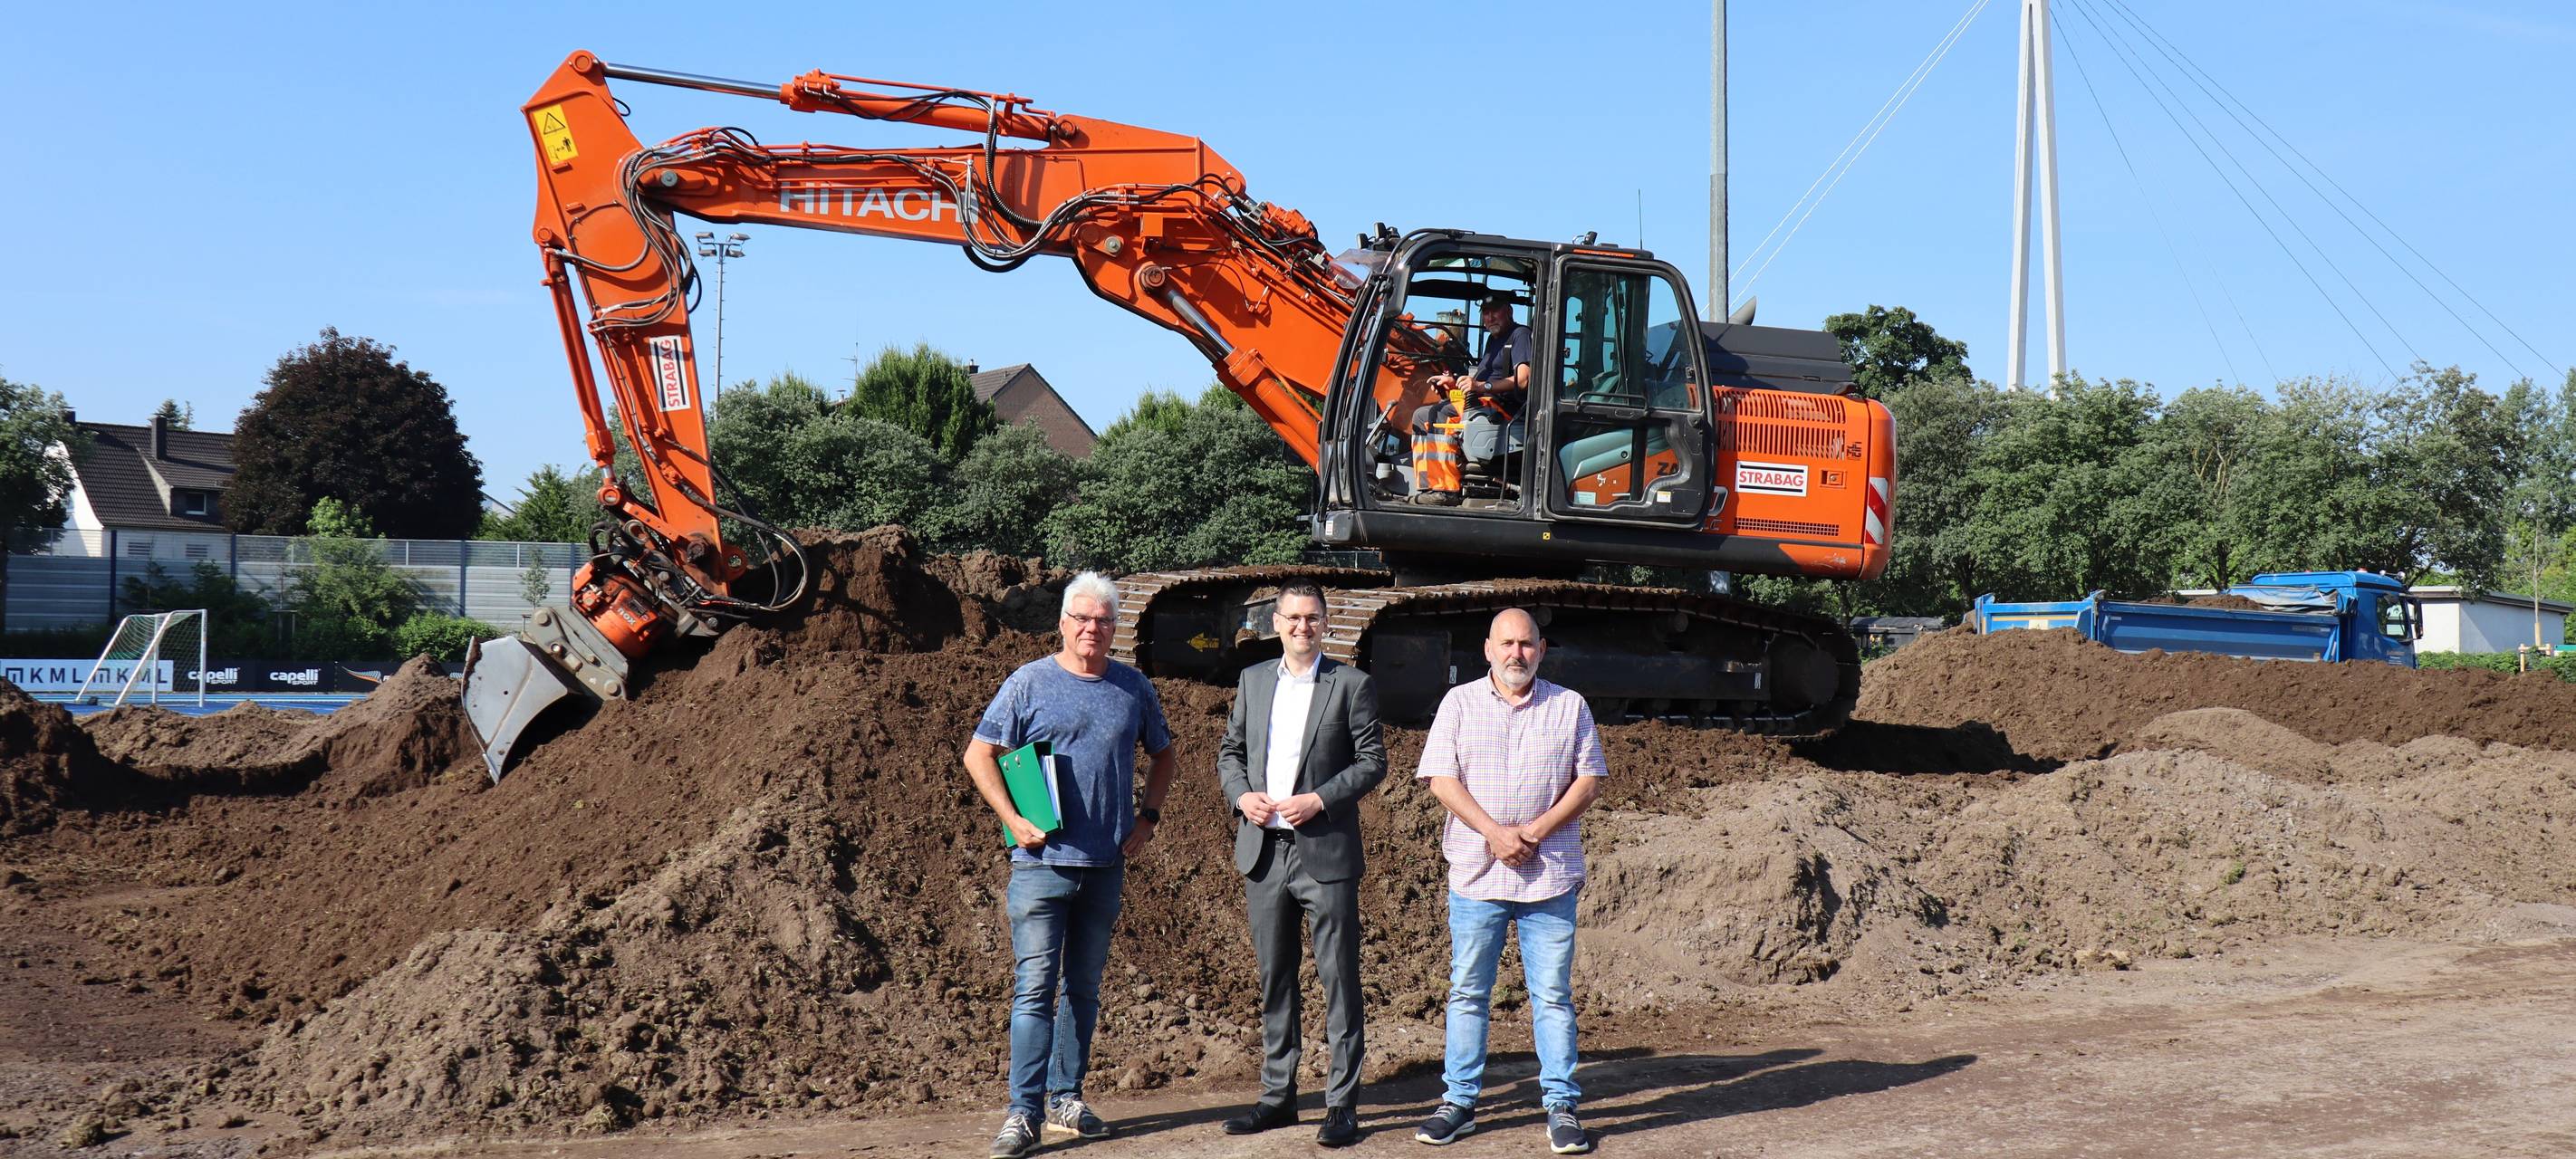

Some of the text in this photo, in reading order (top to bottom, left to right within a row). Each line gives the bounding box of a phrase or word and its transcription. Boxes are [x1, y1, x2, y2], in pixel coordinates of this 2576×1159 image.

[780, 181, 979, 225] HITACHI
[659, 340, 680, 407] STRABAG
[1738, 470, 1804, 487] STRABAG
[30, 667, 83, 684] KML
[117, 667, 168, 684] KML
[269, 668, 319, 684] capelli
